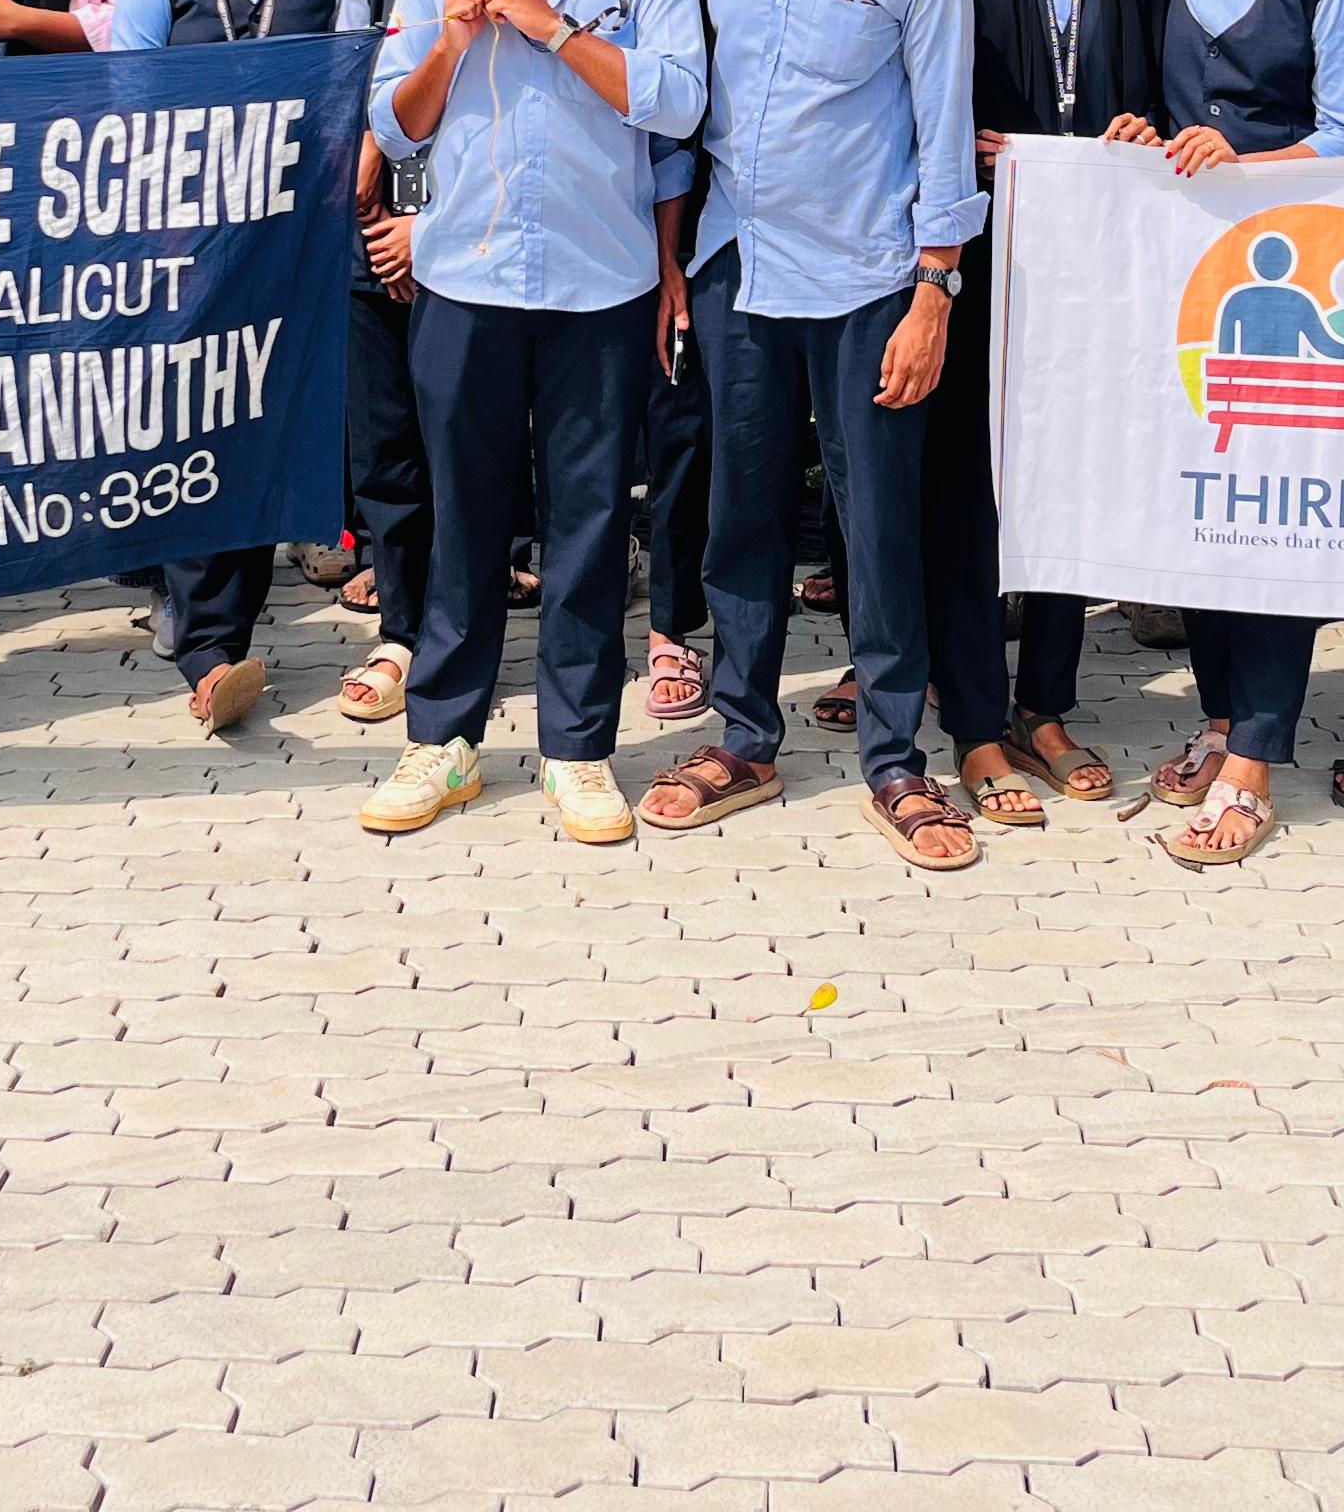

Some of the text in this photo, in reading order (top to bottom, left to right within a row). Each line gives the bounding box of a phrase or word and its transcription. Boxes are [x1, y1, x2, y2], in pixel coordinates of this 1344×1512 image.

[38, 99, 307, 239] SCHEME
[1193, 527, 1278, 548] Kindness
[1285, 531, 1321, 551] that
